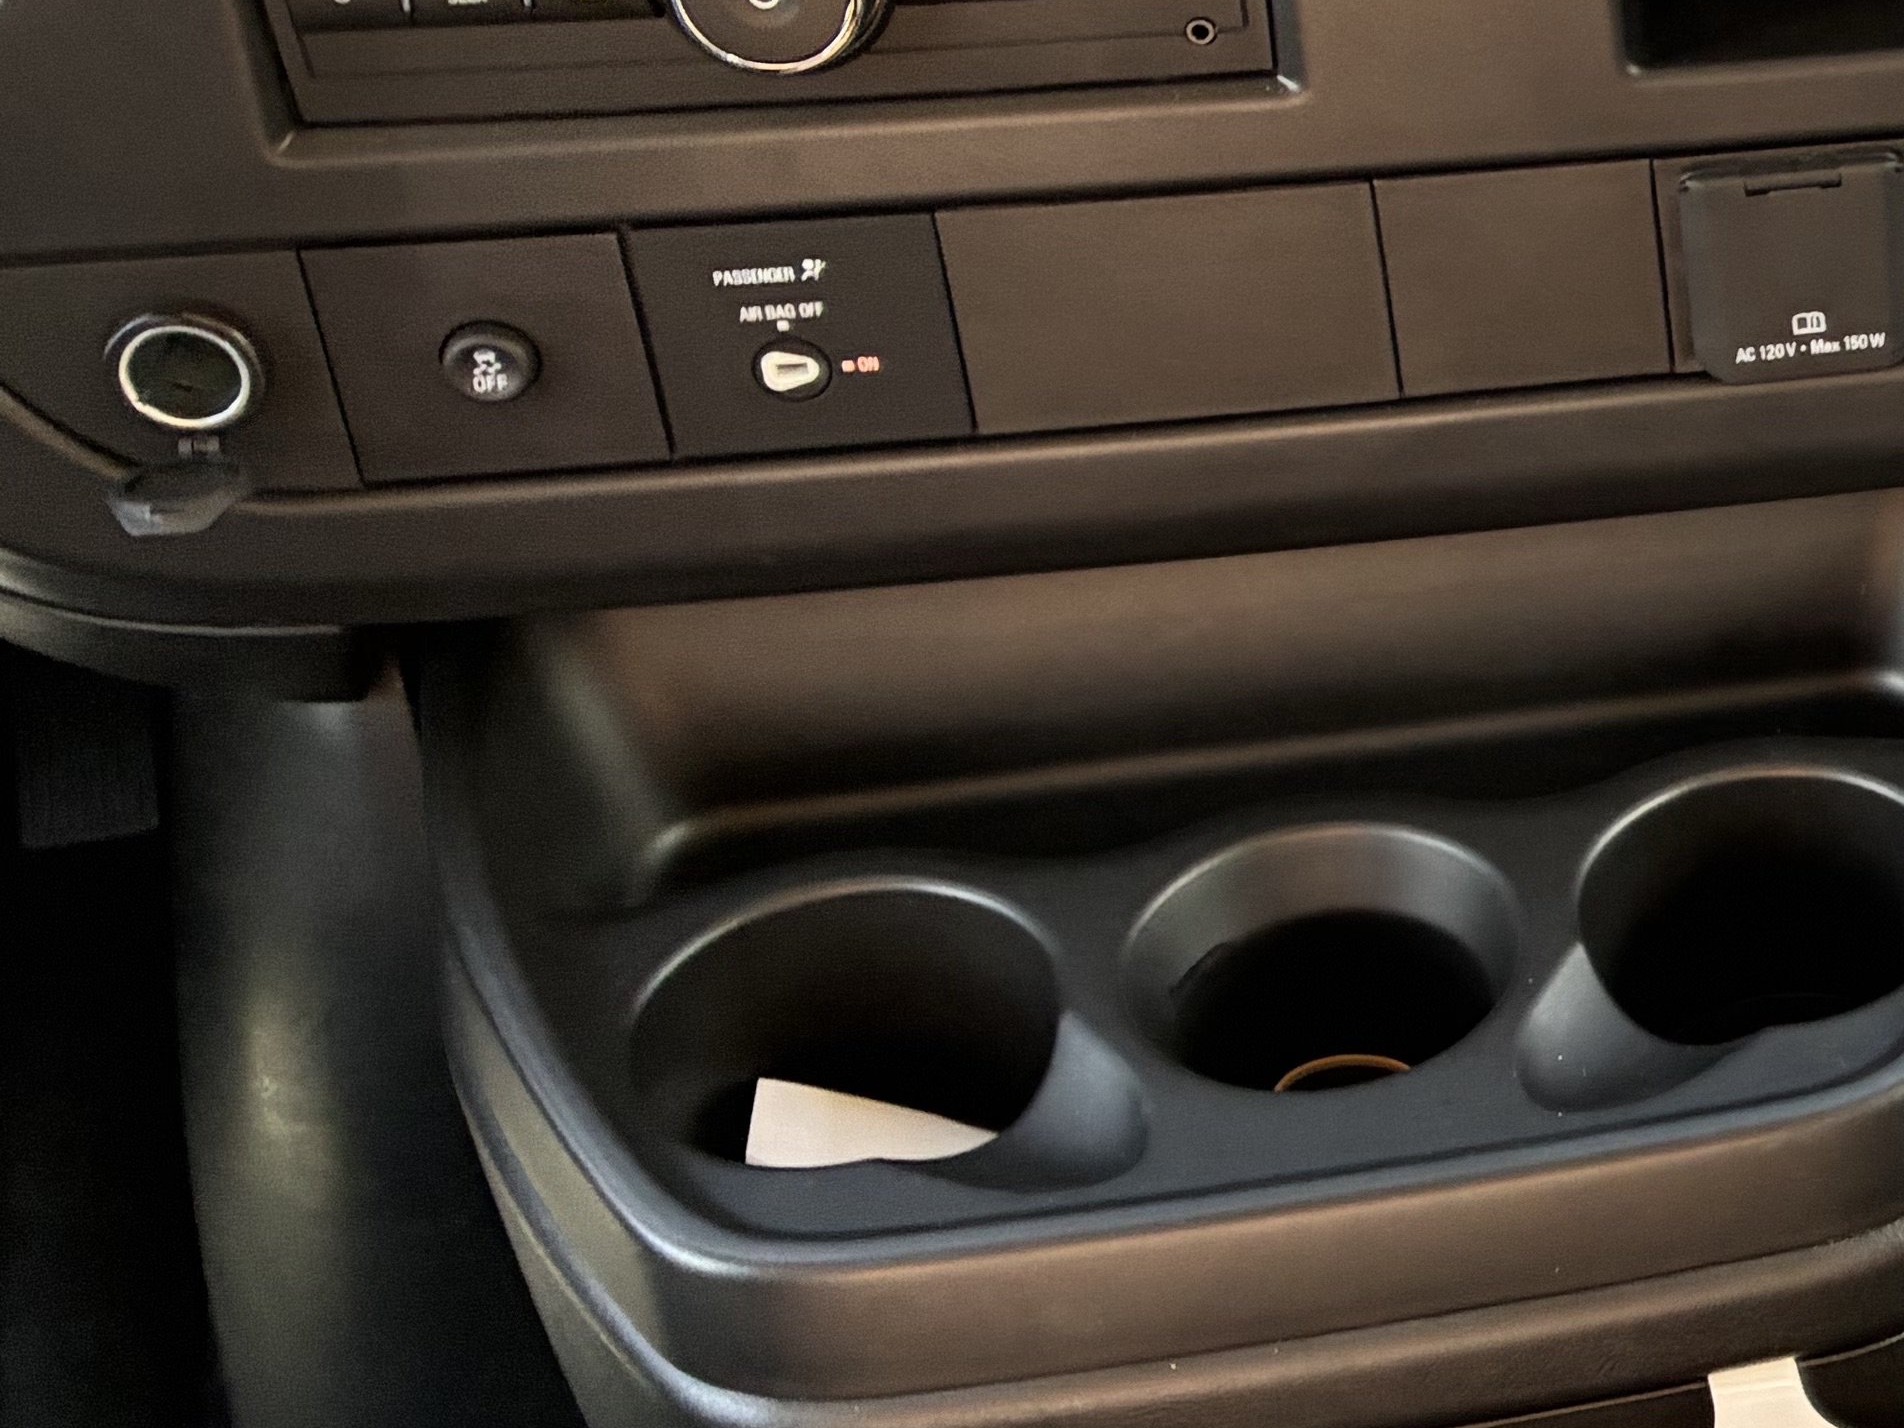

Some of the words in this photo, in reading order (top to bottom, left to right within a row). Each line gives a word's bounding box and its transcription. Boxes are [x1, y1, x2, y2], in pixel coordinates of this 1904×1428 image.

[712, 266, 796, 287] PASSENGER
[739, 305, 763, 323] AIR
[764, 303, 796, 320] BAG
[798, 301, 824, 319] OFF
[1735, 346, 1756, 364] AC
[1810, 338, 1841, 355] Max
[857, 356, 880, 372] ON
[472, 374, 508, 393] OFF
